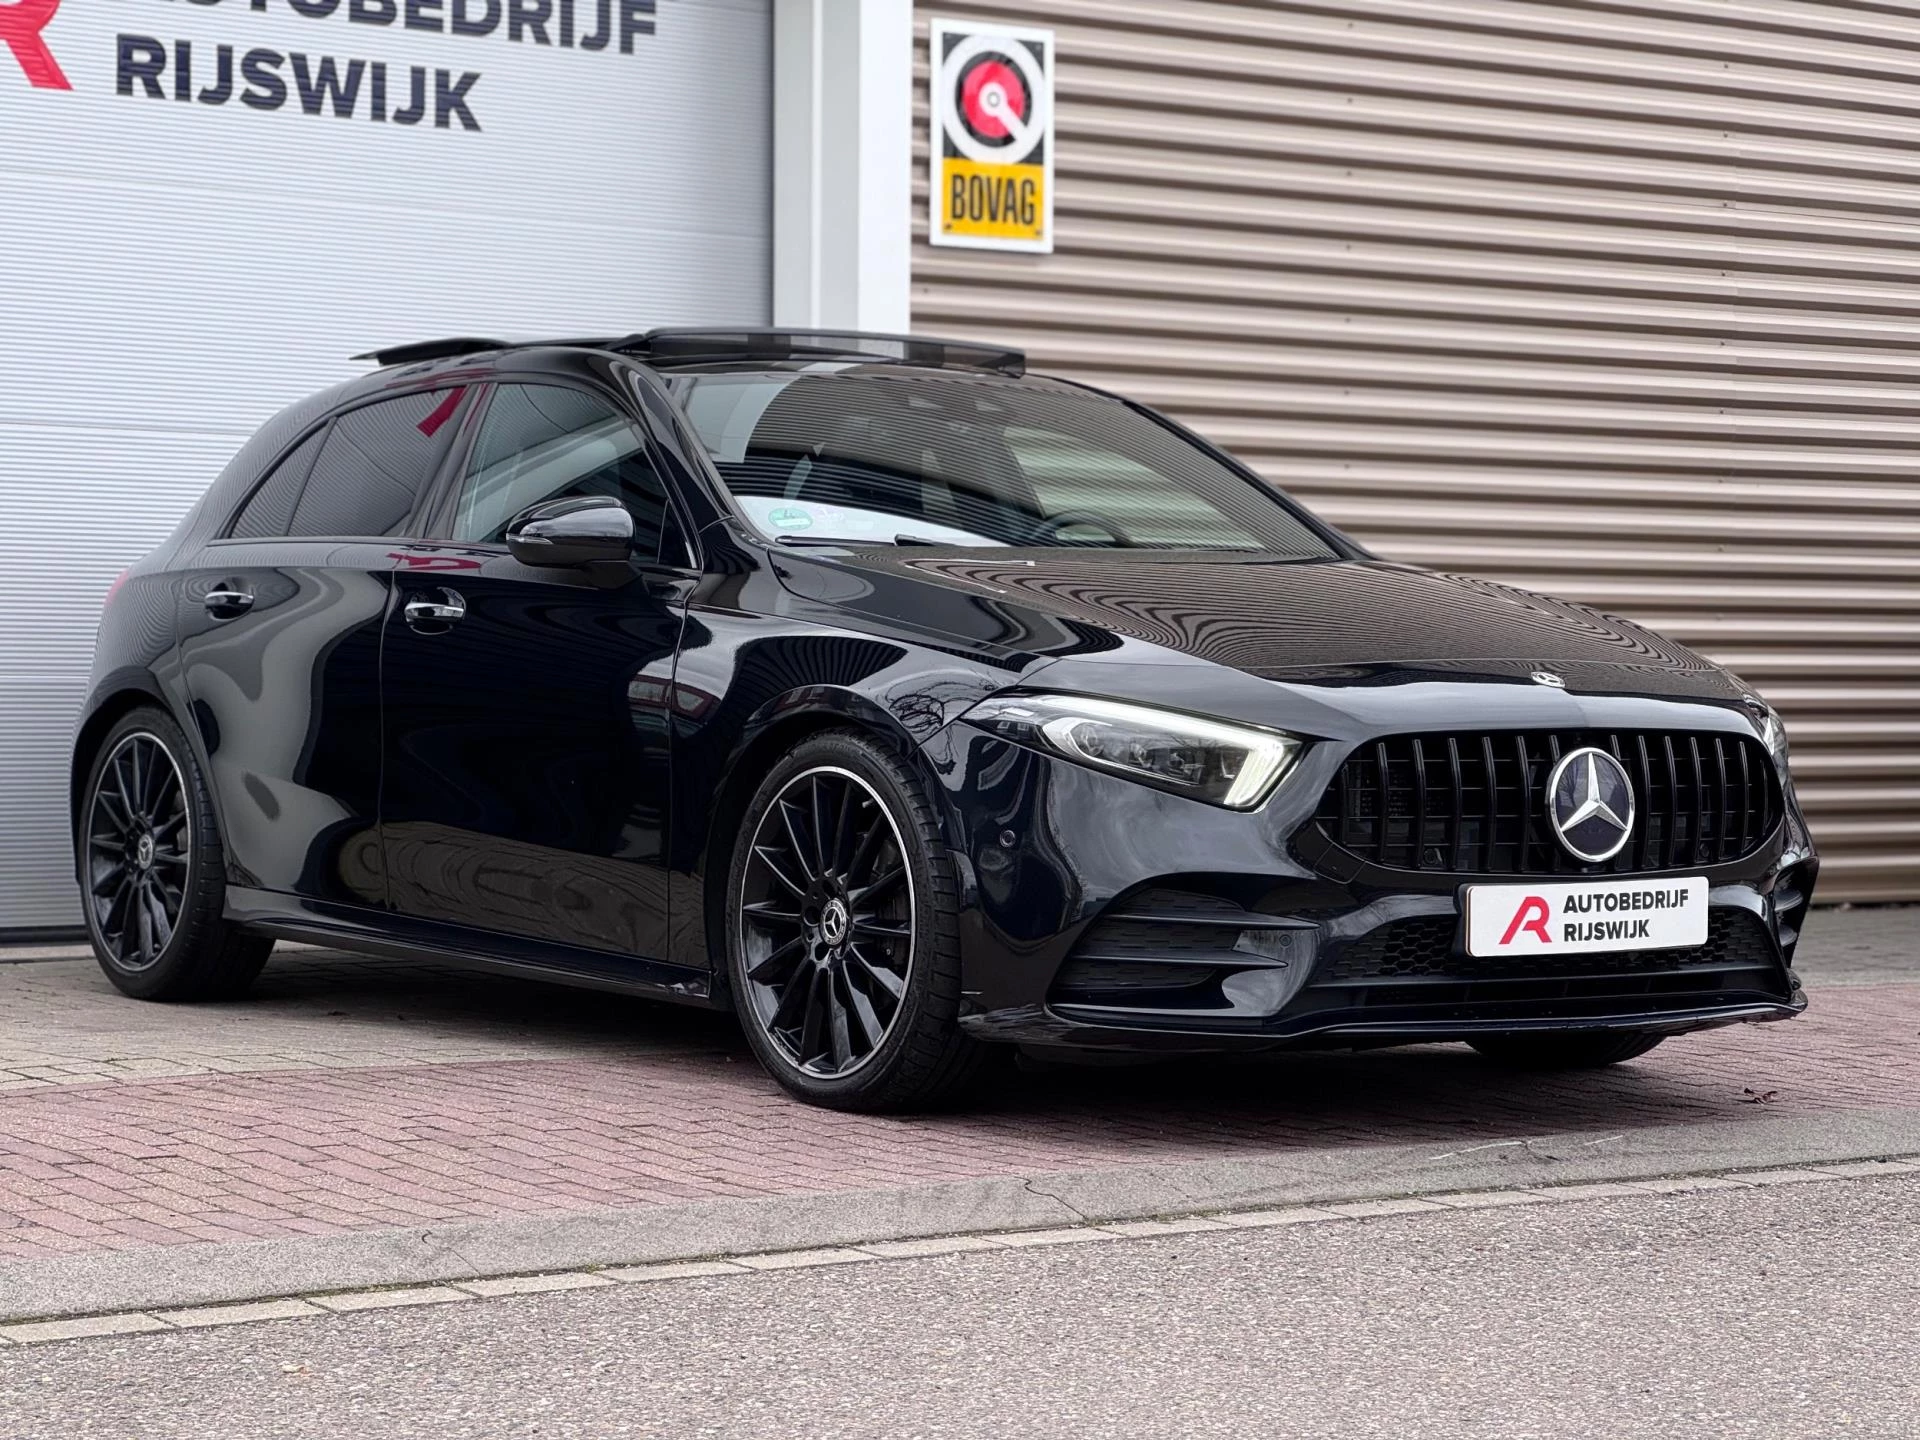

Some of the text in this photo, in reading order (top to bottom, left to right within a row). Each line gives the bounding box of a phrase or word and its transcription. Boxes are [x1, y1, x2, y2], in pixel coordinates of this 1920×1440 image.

[164, 0, 656, 55] EDRIJF
[116, 33, 483, 132] RIJSWIJK
[951, 174, 1035, 225] BOVAG
[1563, 889, 1689, 914] AUTOBEDRIJF
[1563, 919, 1650, 942] RIJSWIJK
